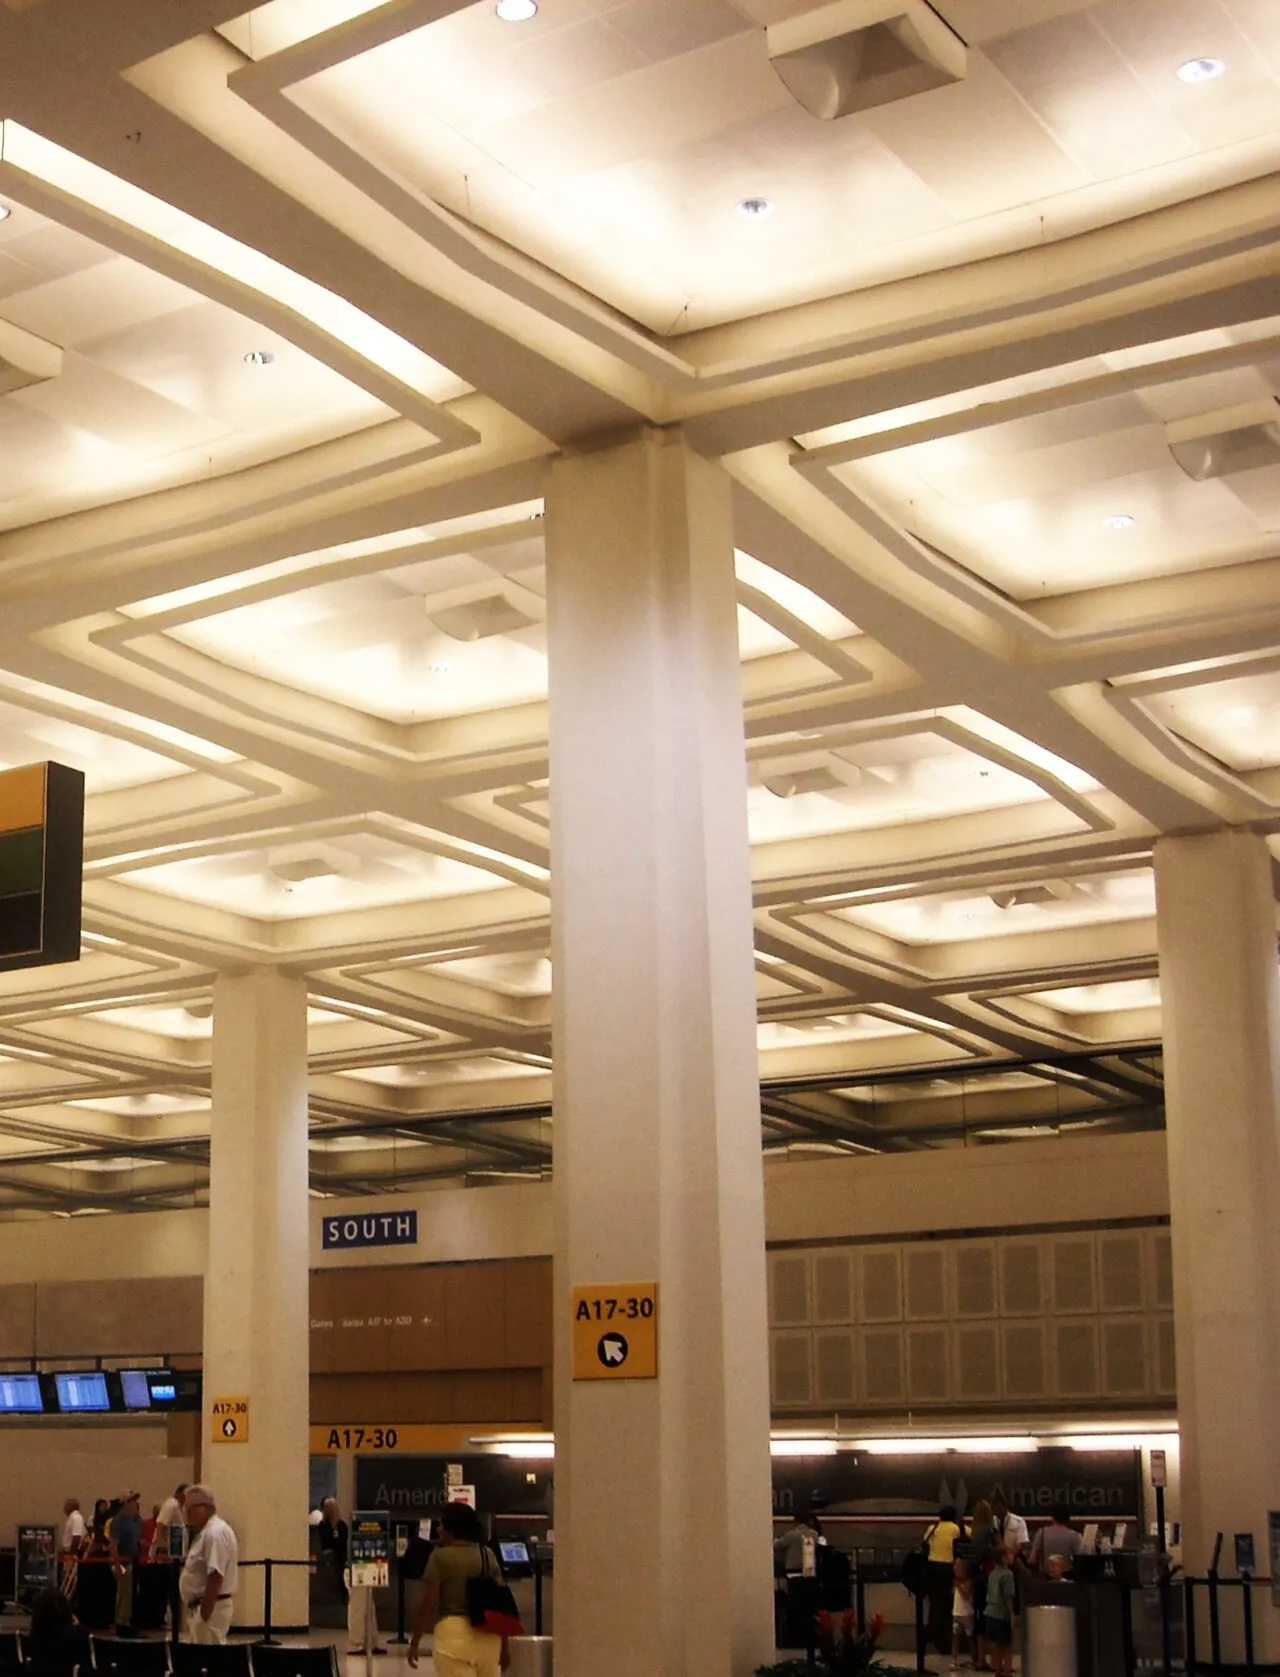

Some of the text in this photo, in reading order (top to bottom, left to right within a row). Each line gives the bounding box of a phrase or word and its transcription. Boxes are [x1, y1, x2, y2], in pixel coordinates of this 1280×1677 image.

[328, 1215, 411, 1242] SOUTH
[575, 1297, 654, 1321] A17-30
[212, 1403, 247, 1415] A17-30
[326, 1427, 398, 1450] A17-30
